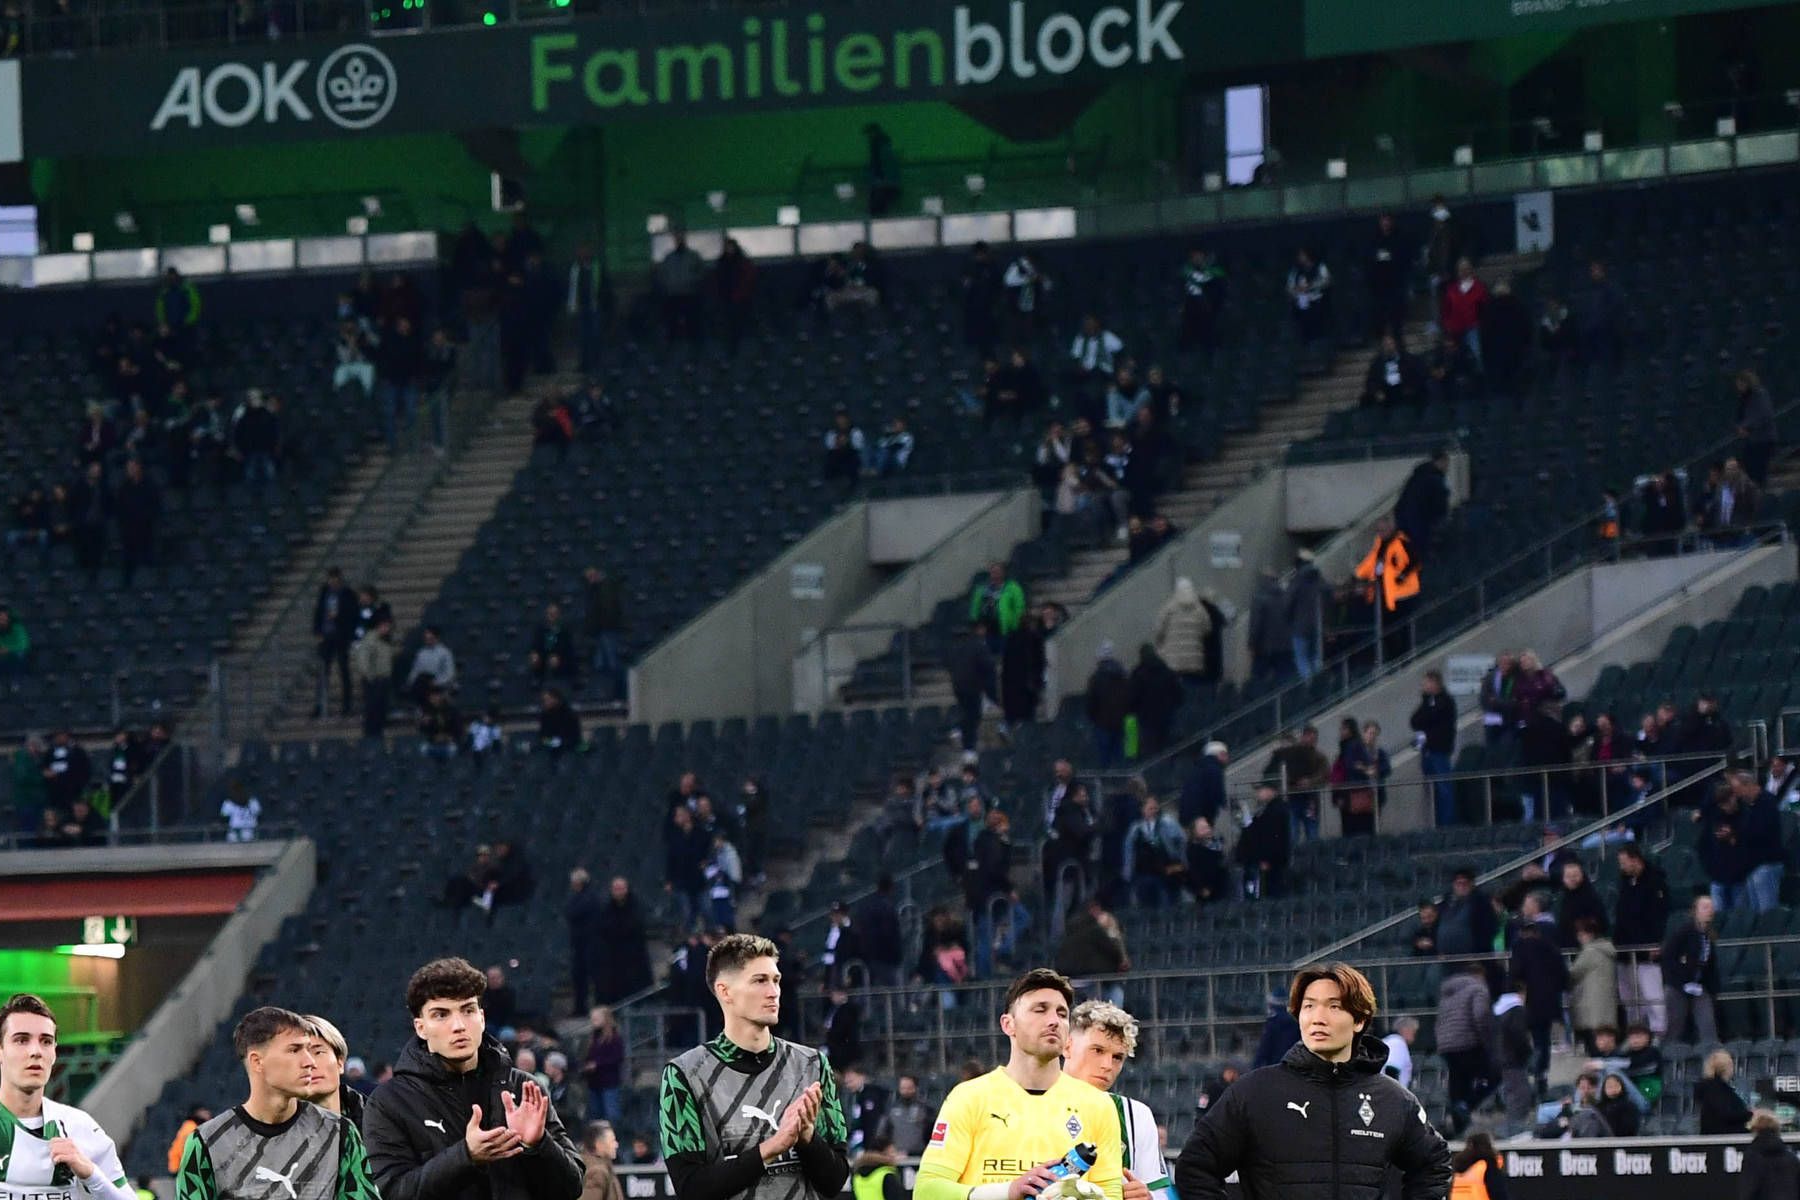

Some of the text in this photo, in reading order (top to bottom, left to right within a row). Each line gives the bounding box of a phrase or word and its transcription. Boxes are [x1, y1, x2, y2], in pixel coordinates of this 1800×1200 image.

[530, 1, 1184, 112] Familienblock
[150, 60, 313, 130] AOK
[983, 1158, 1046, 1172] REU
[1507, 1151, 1543, 1177] Brax
[1559, 1151, 1598, 1176] Brax
[1614, 1149, 1652, 1175] Brax
[1668, 1148, 1707, 1174] Brax
[1724, 1147, 1744, 1173] Br
